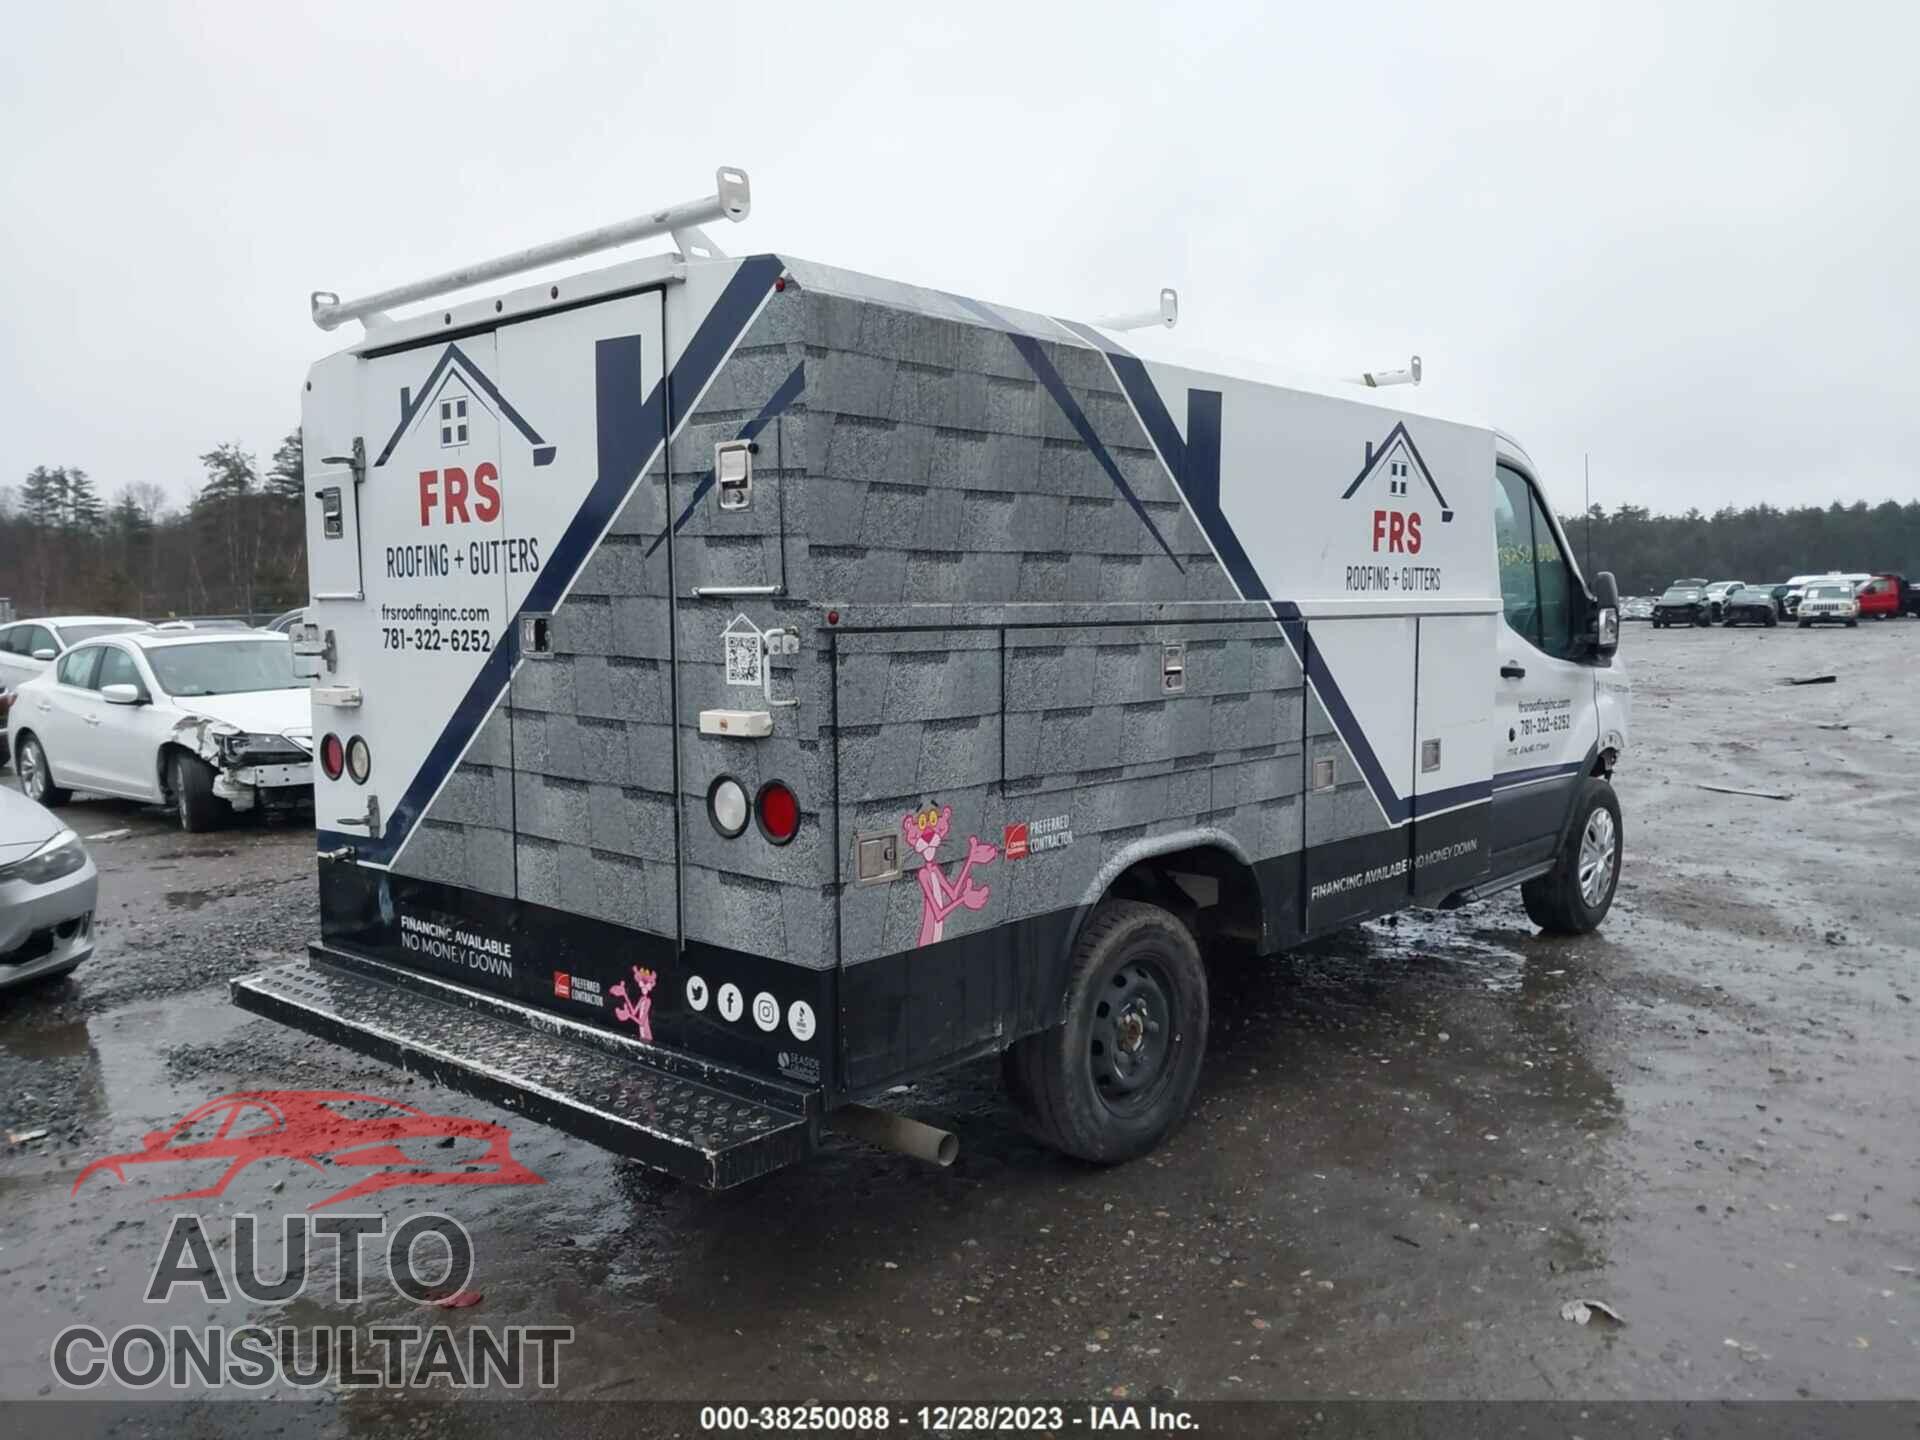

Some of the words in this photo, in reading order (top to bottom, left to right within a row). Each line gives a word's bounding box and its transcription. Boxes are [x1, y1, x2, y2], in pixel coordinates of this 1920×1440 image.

[419, 462, 501, 527] FRS
[1373, 510, 1422, 555] FRS
[386, 543, 449, 578] ROOFING
[454, 549, 465, 569] +
[469, 537, 540, 575] GUTTERS
[1346, 565, 1390, 591] ROOFING
[1392, 571, 1400, 586] +
[1401, 567, 1441, 591] GUTTERS
[381, 603, 490, 626] frsroofinginc.com
[382, 628, 491, 652] 781-322-6252
[1520, 713, 1570, 736] 781-322-6252
[1030, 814, 1070, 836] PREFERRED
[1030, 830, 1073, 853] CONTRACTOR
[1311, 873, 1363, 901] FINANCING
[1425, 846, 1454, 864] MONEY
[1454, 838, 1478, 857] DOWN
[401, 915, 453, 941] FINANCING
[455, 931, 512, 958] AVAILABLE
[402, 931, 420, 950] NO
[422, 938, 467, 964] MONEY
[469, 951, 513, 979] DOWN
